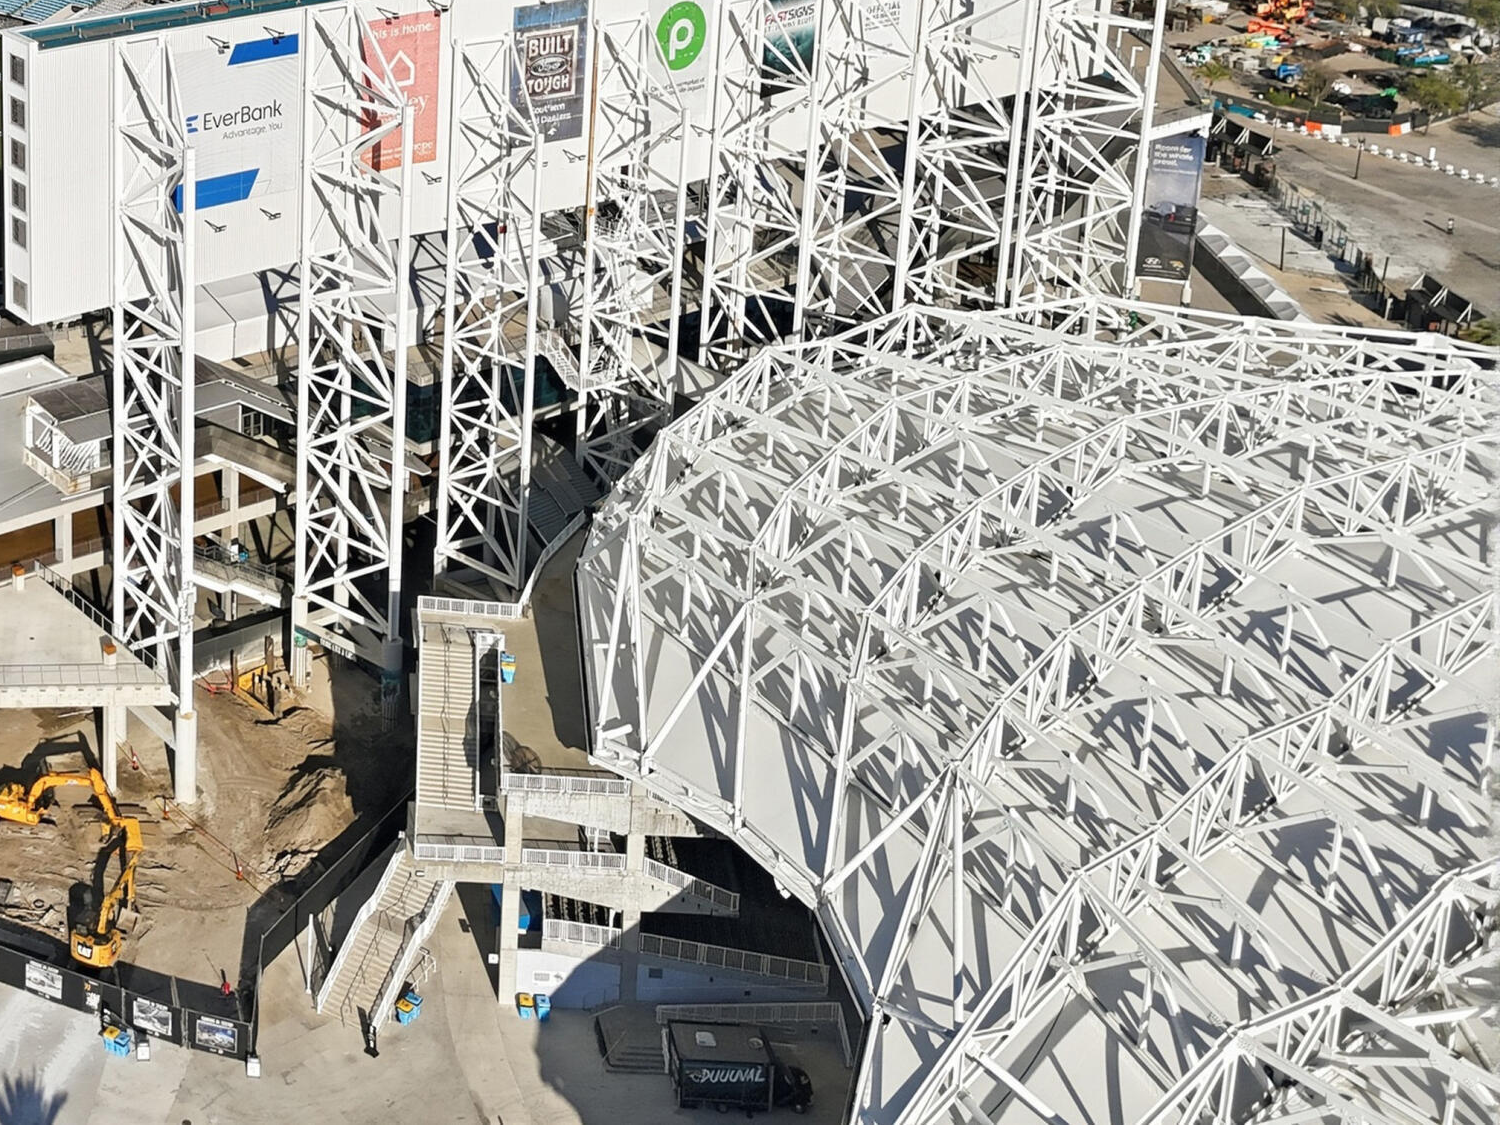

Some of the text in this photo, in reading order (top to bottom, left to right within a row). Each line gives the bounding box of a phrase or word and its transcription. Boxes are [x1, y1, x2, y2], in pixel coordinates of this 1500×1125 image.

[528, 35, 573, 57] BUILT
[527, 74, 570, 95] TOUGH
[203, 99, 283, 131] EverBank
[78, 945, 92, 958] CAT
[700, 1065, 765, 1083] DUUUVAL
